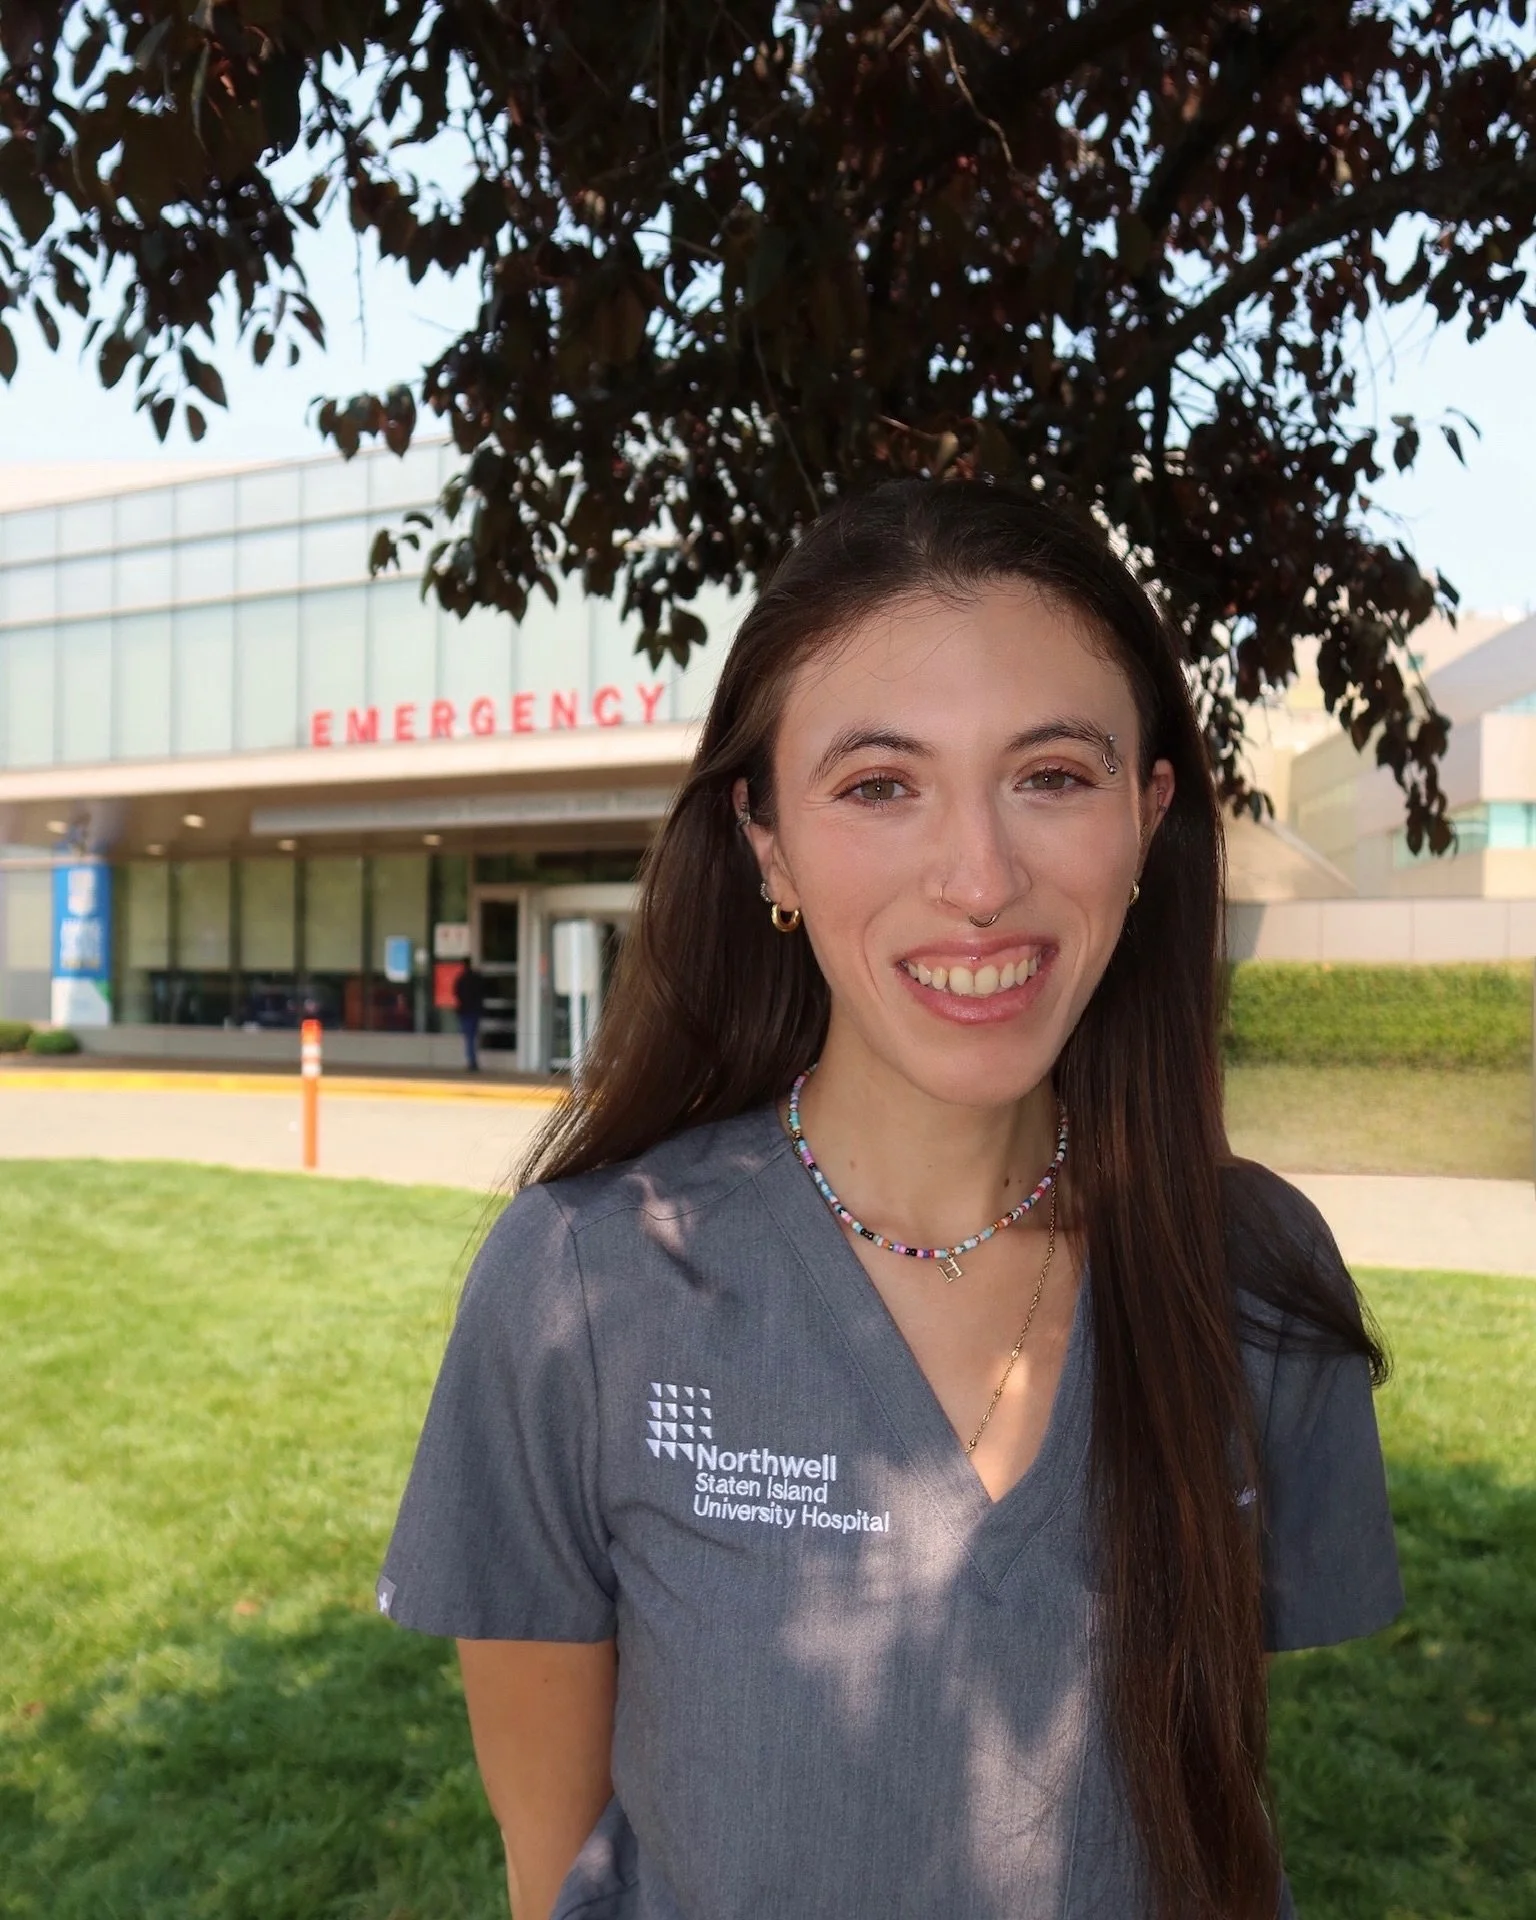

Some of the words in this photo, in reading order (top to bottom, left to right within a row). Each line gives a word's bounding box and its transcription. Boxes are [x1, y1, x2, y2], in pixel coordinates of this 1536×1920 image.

[311, 682, 665, 748] EMERGENCY
[696, 1443, 837, 1481] Northwell
[695, 1472, 761, 1497] Staten
[767, 1476, 828, 1504] Island
[693, 1494, 796, 1529] University
[802, 1504, 889, 1534] Hospital
